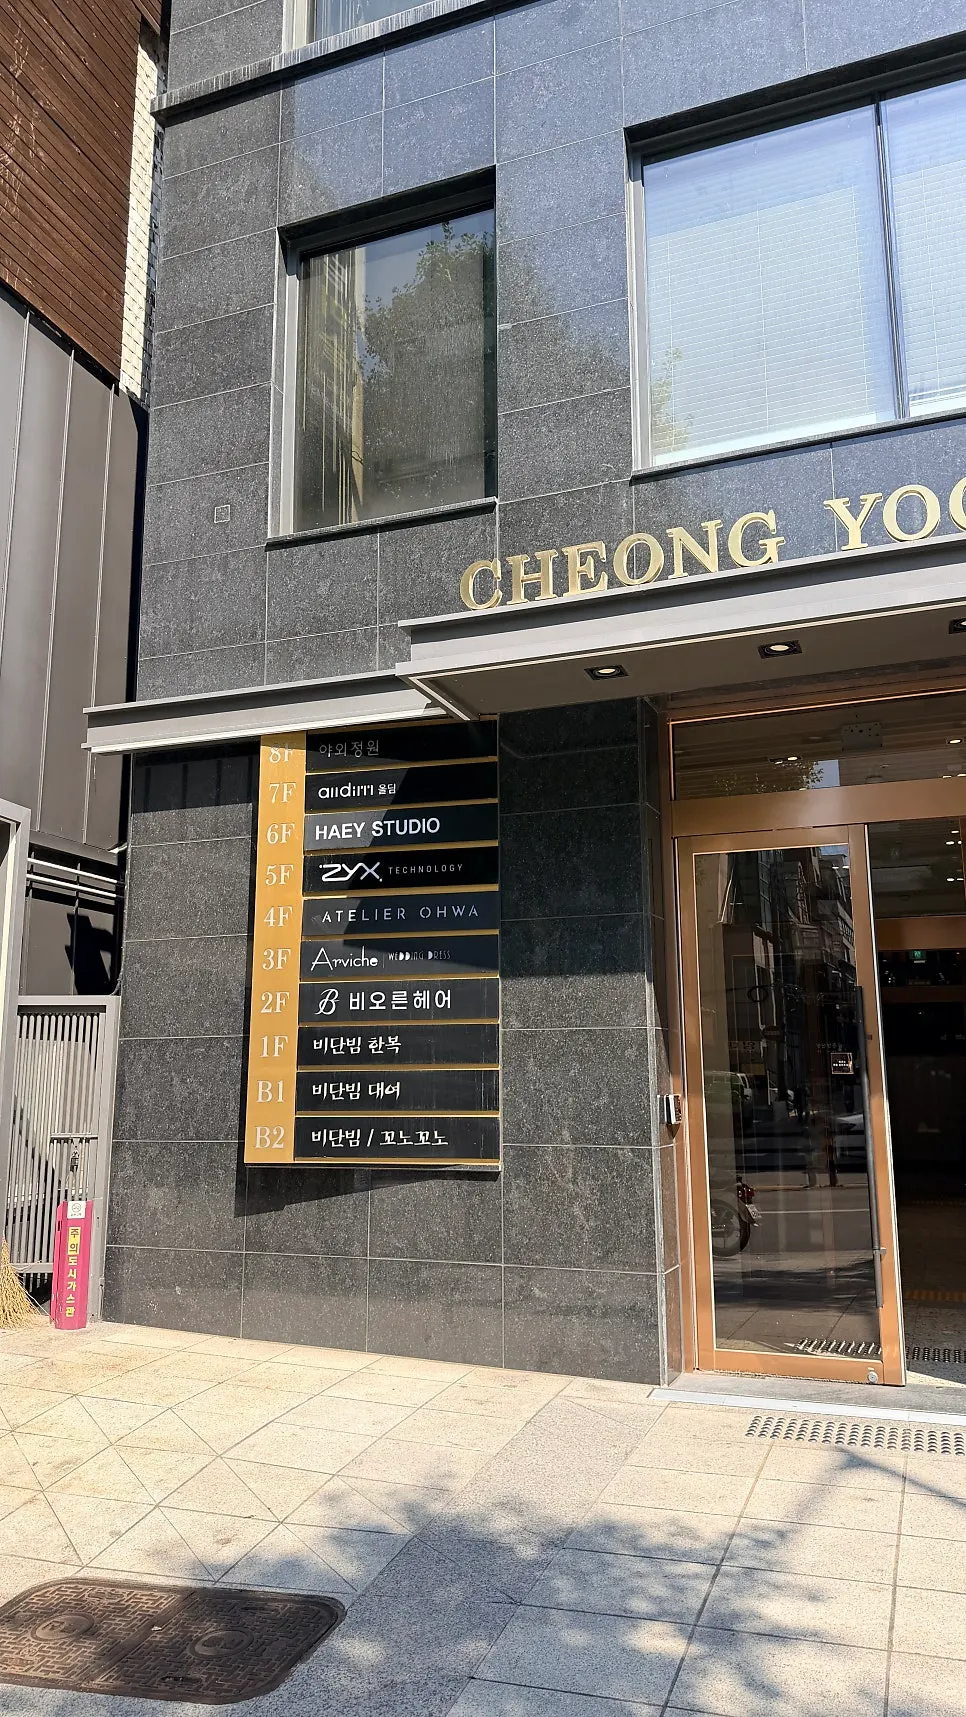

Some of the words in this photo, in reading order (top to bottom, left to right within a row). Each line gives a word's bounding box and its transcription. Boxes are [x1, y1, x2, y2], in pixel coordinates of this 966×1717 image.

[460, 510, 785, 611] CHEONG
[823, 476, 966, 551] YO
[268, 743, 295, 764] 8F
[319, 739, 380, 758] 야외정원
[268, 782, 297, 804] 7F
[266, 823, 295, 845] 6F
[315, 822, 366, 840] HAEY
[371, 817, 440, 836] STUDIO
[265, 864, 294, 886] 5F
[388, 863, 463, 875] TECHNOLOGY
[264, 905, 293, 927] 4F
[322, 907, 406, 923] ATELIER
[419, 904, 478, 918] OHWA
[262, 948, 291, 971] 3F
[310, 946, 379, 972] Arviche
[427, 950, 451, 960] DRESS
[260, 991, 290, 1014] 2F
[349, 989, 452, 1011] 비오른헤어
[260, 1035, 289, 1058] 1F
[313, 1037, 362, 1055] 비단빔
[368, 1035, 402, 1054] 한복
[256, 1080, 284, 1104] B1
[312, 1082, 361, 1101] 비단빔
[368, 1081, 401, 1100] 대여
[255, 1125, 285, 1149] B2
[311, 1128, 361, 1148] 비단빔
[379, 1130, 449, 1146] 꼬노꼬노
